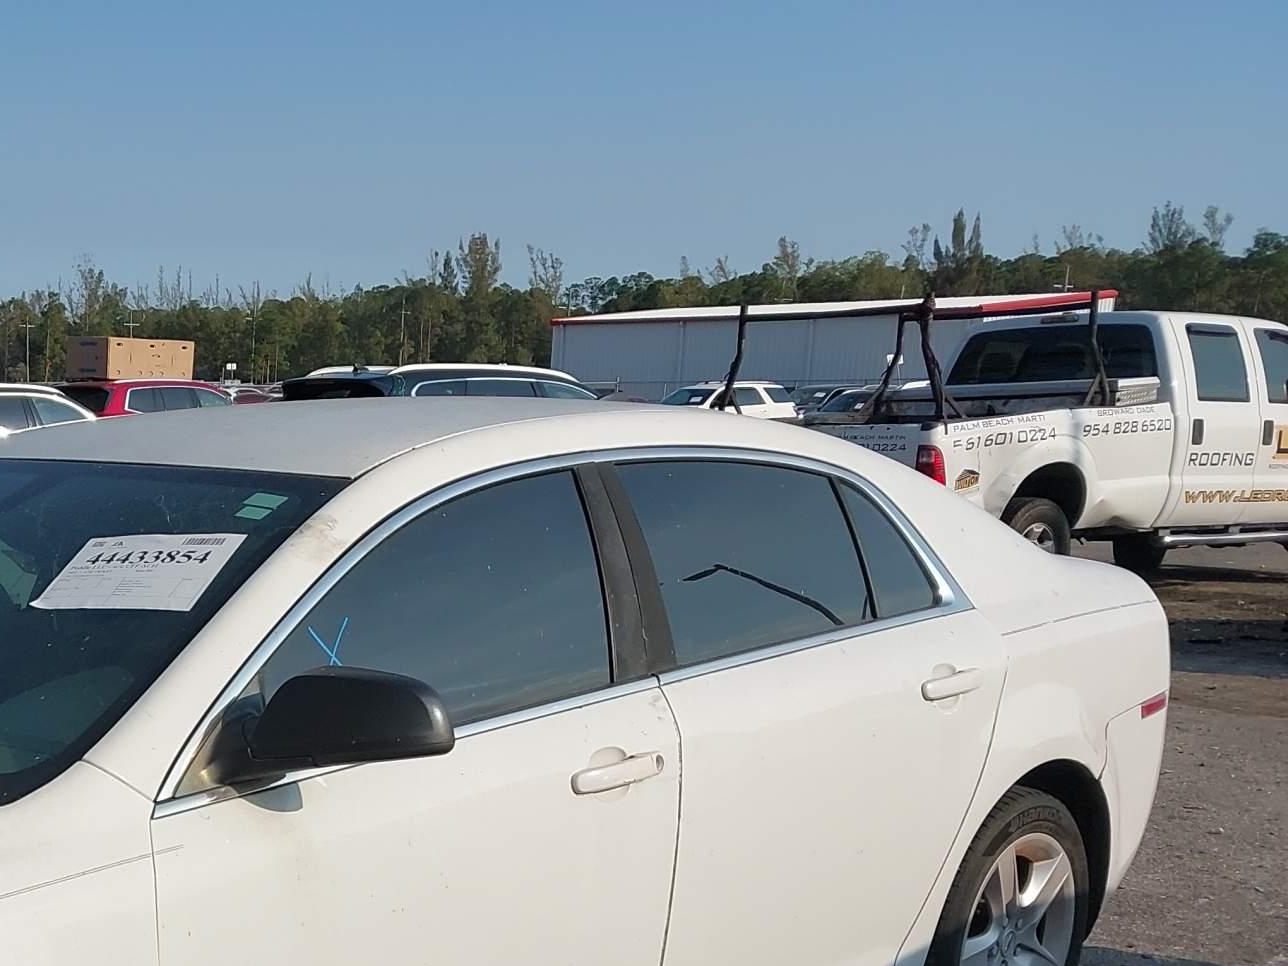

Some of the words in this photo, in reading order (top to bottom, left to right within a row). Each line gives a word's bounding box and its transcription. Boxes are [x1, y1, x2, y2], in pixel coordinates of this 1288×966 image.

[1097, 407, 1135, 417] BROWARD
[1137, 406, 1155, 414] DADE
[953, 422, 980, 432] PALM
[982, 417, 1014, 428] BEACH
[1083, 423, 1110, 437] 954
[1113, 421, 1138, 434] 828
[1141, 418, 1172, 432] 6520
[984, 432, 1014, 447] 601
[1017, 427, 1056, 443] 0224
[1188, 452, 1255, 466] ROOFING
[86, 550, 213, 565] 44433854
